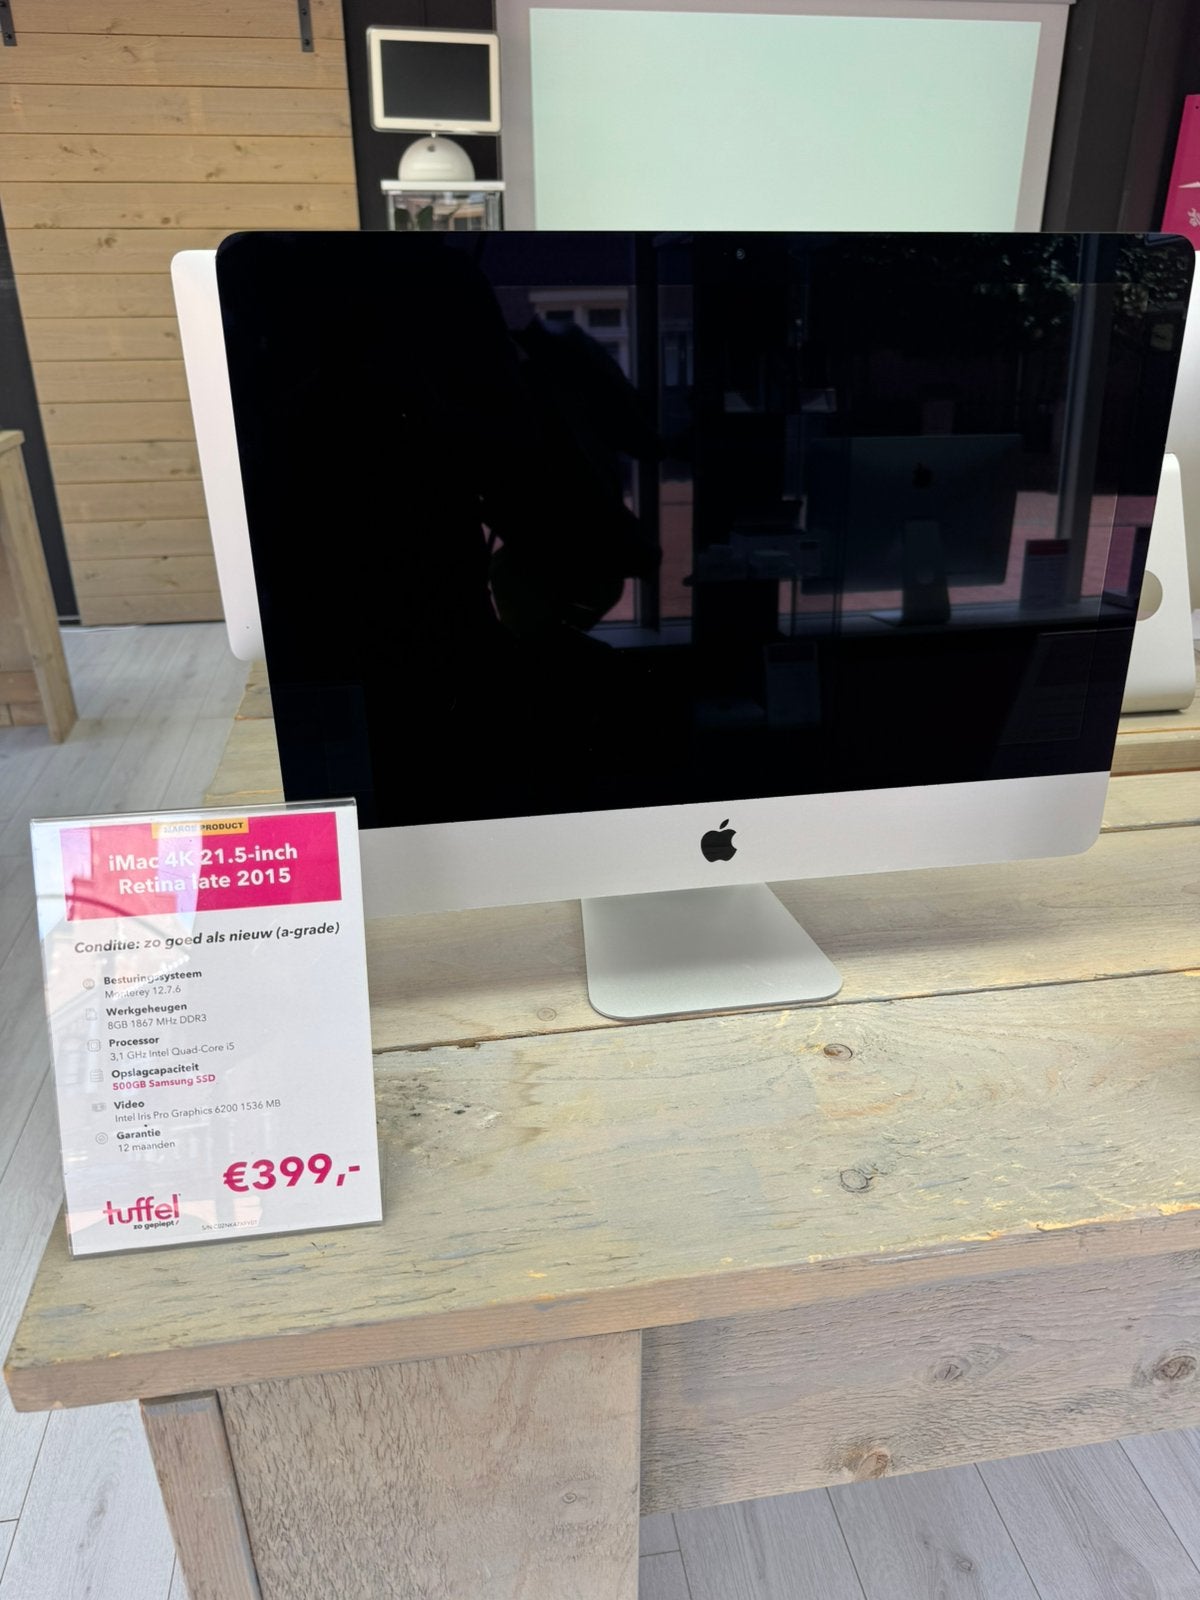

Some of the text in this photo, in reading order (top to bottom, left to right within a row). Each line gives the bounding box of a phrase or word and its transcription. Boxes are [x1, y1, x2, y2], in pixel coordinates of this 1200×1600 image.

[200, 822, 244, 831] PRODUCT
[108, 842, 298, 872] iMac 4K 21.5-inch
[118, 867, 291, 895] Retina late 2015
[74, 921, 341, 954] Conditie: zo goed als nieuw (a-grade)
[153, 984, 182, 996] 12.7.6
[105, 1003, 188, 1017] Werkgeheugen
[107, 1013, 208, 1031] 8GB 1867 MHz DDR3
[108, 1036, 160, 1047] Processor
[126, 1050, 147, 1060] GHz
[148, 1047, 169, 1058] Intel
[171, 1044, 224, 1056] Quad-Core
[226, 1041, 236, 1051] i5
[111, 1062, 200, 1079] Opslagcapaciteit
[112, 1074, 216, 1091] 500GB Samsung SSD
[113, 1099, 145, 1110] Video
[115, 1099, 281, 1123] Intel Iris Pro Graphics 6200 1536 MB
[116, 1128, 162, 1140] Garantie
[118, 1140, 176, 1152] 12 maanden
[222, 1152, 361, 1193] €399,-
[102, 1193, 180, 1226] tuffel
